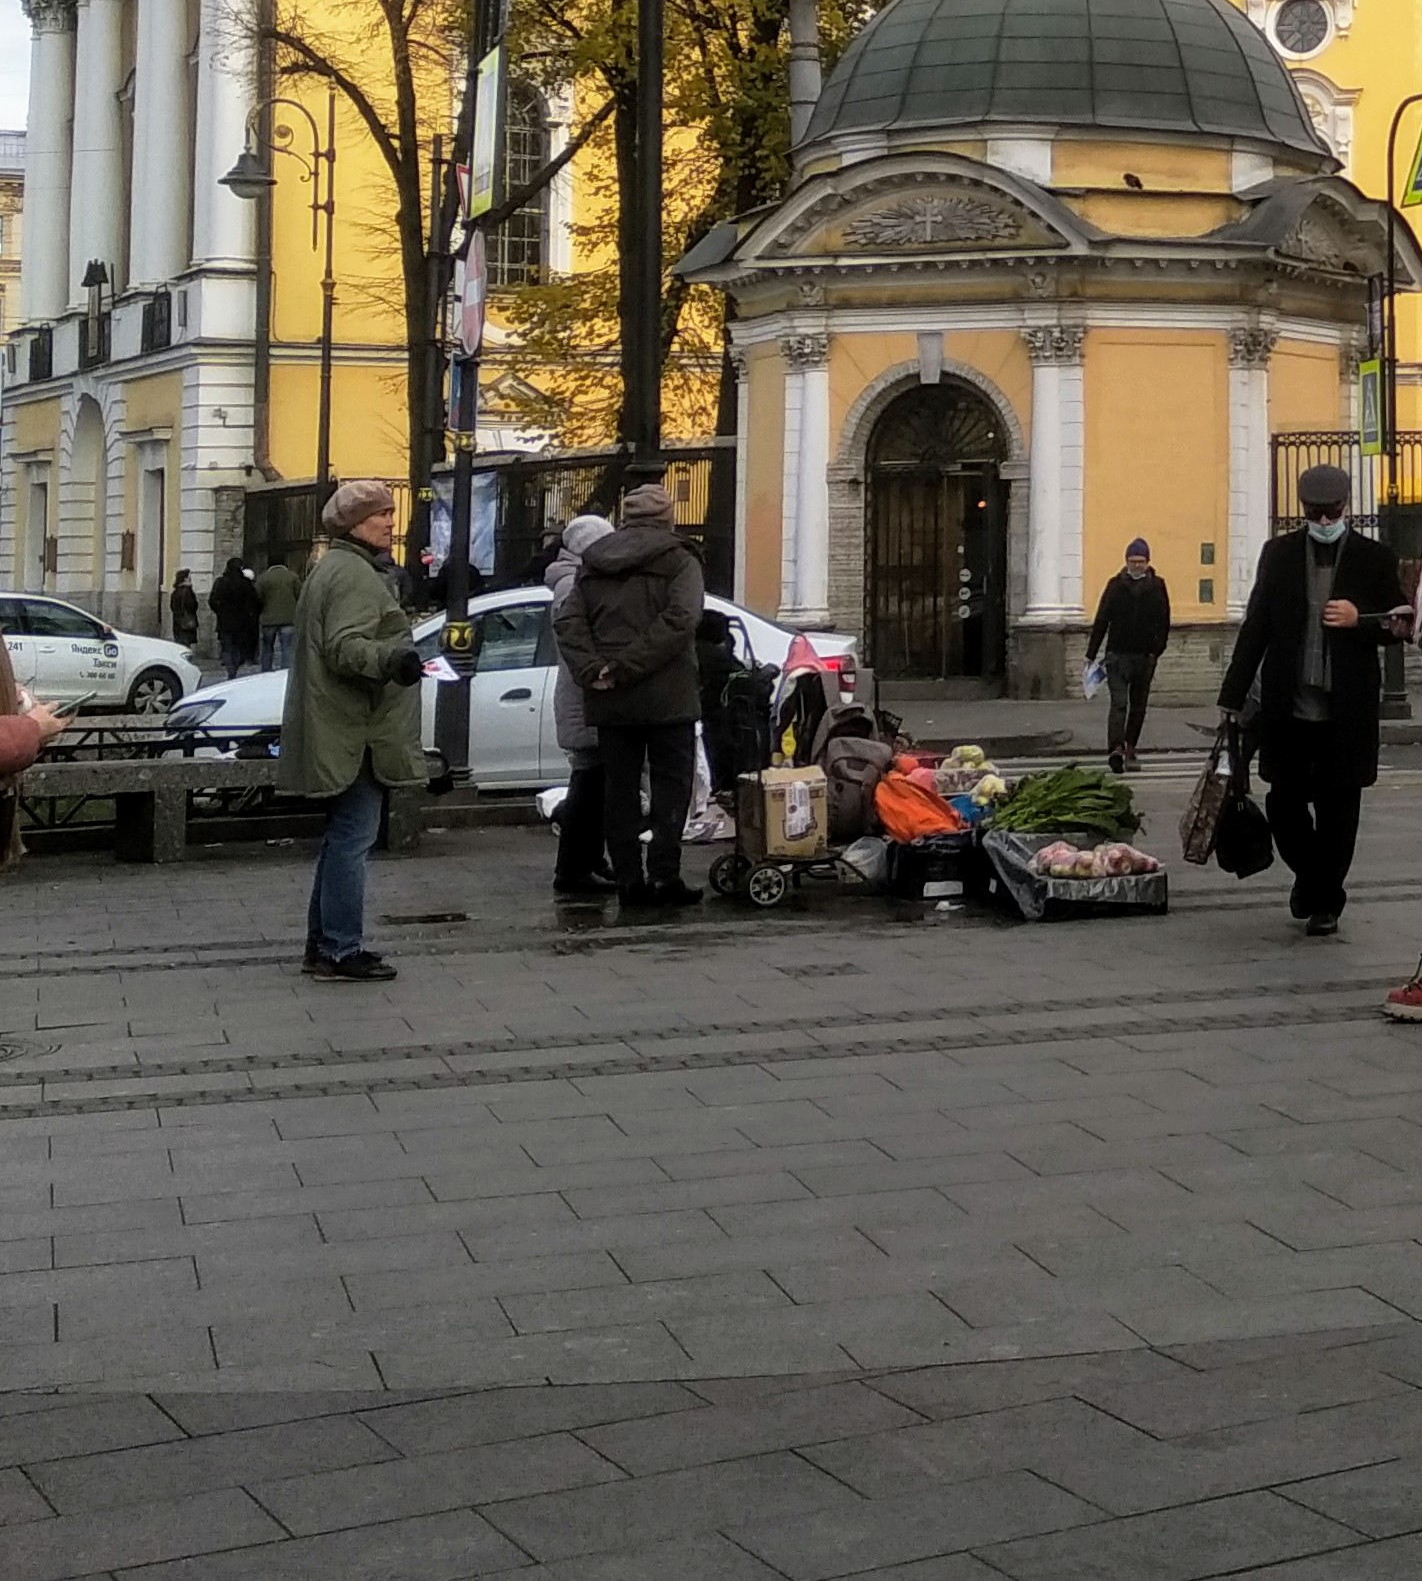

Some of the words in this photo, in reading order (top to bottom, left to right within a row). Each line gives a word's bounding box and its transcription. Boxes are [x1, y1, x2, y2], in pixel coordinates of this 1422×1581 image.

[8, 641, 23, 652] 241
[71, 643, 102, 656] Яндекс
[105, 645, 117, 656] Go
[93, 658, 117, 669] Такси
